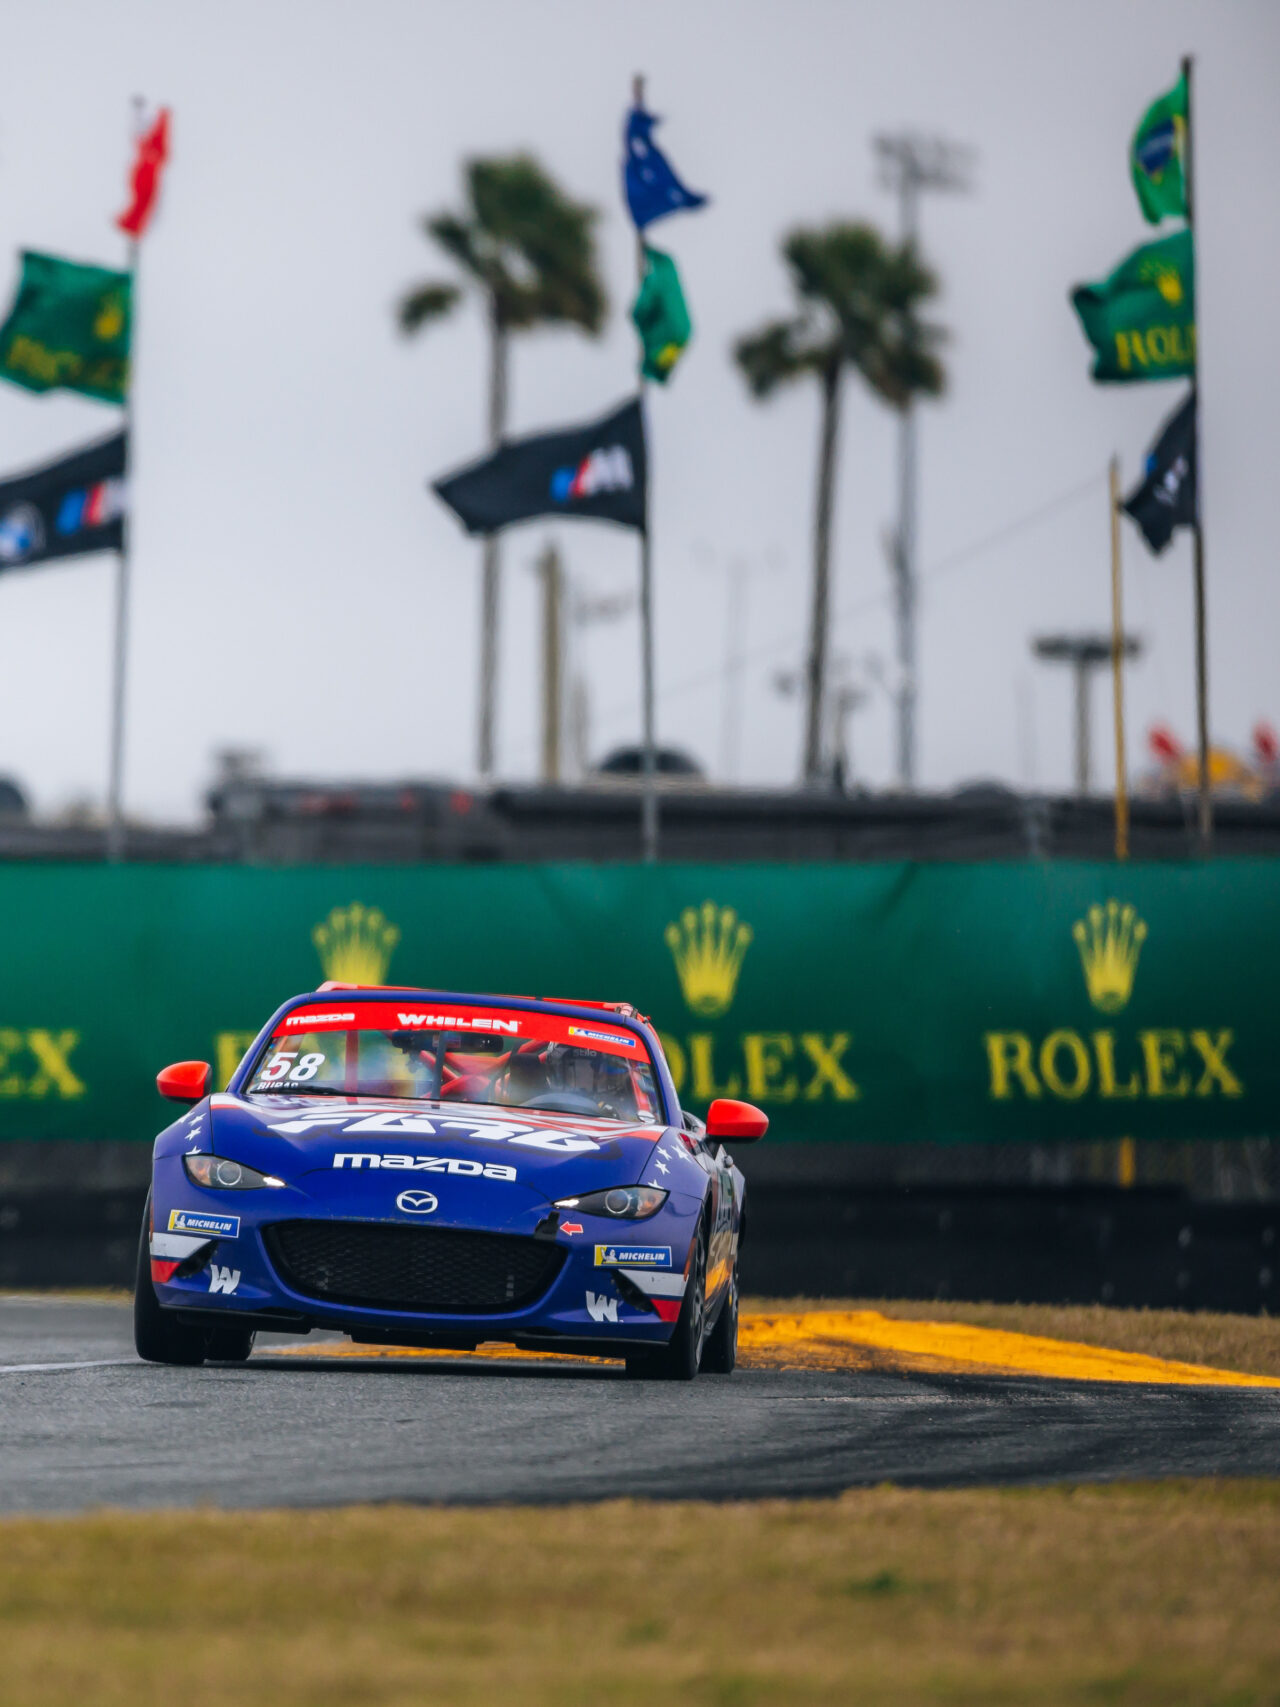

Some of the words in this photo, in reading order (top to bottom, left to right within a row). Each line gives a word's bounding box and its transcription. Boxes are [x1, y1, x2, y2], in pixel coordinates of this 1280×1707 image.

[260, 1051, 326, 1081] 58
[985, 1029, 1243, 1099] ROLEX
[186, 1218, 232, 1231] MICHELIN
[618, 1252, 666, 1261] MICHELIN
